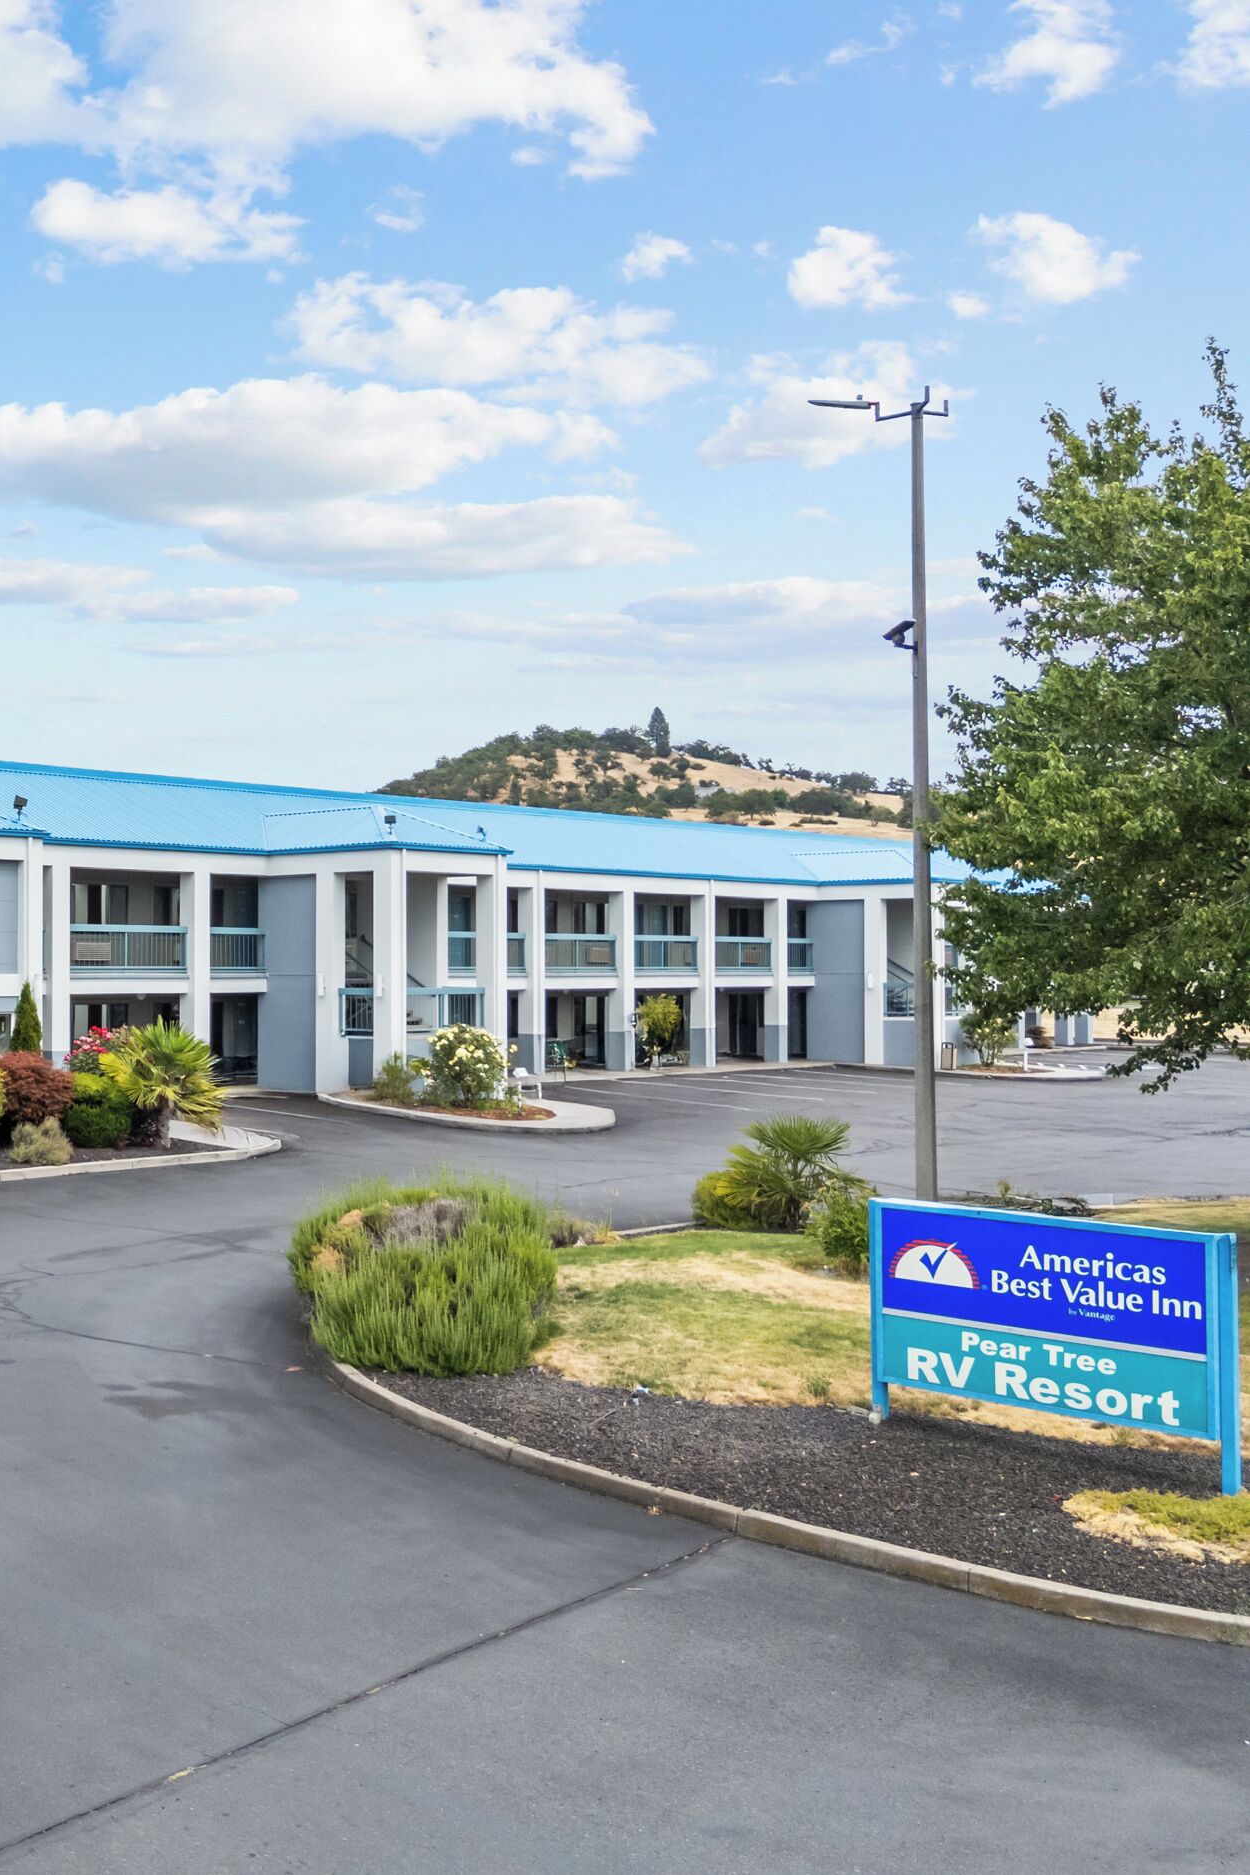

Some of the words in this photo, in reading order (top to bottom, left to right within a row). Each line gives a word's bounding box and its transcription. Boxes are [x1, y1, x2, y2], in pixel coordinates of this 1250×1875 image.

[1019, 1244, 1167, 1285] Americas
[991, 1269, 1053, 1301] Best
[1060, 1278, 1144, 1313] Value
[1152, 1289, 1202, 1320] Inn
[1068, 1308, 1077, 1316] by
[1078, 1308, 1116, 1322] Vantage
[961, 1330, 1032, 1361] Pear
[1043, 1343, 1117, 1376] Tree
[907, 1346, 976, 1389] RV
[994, 1361, 1180, 1427] Resort
